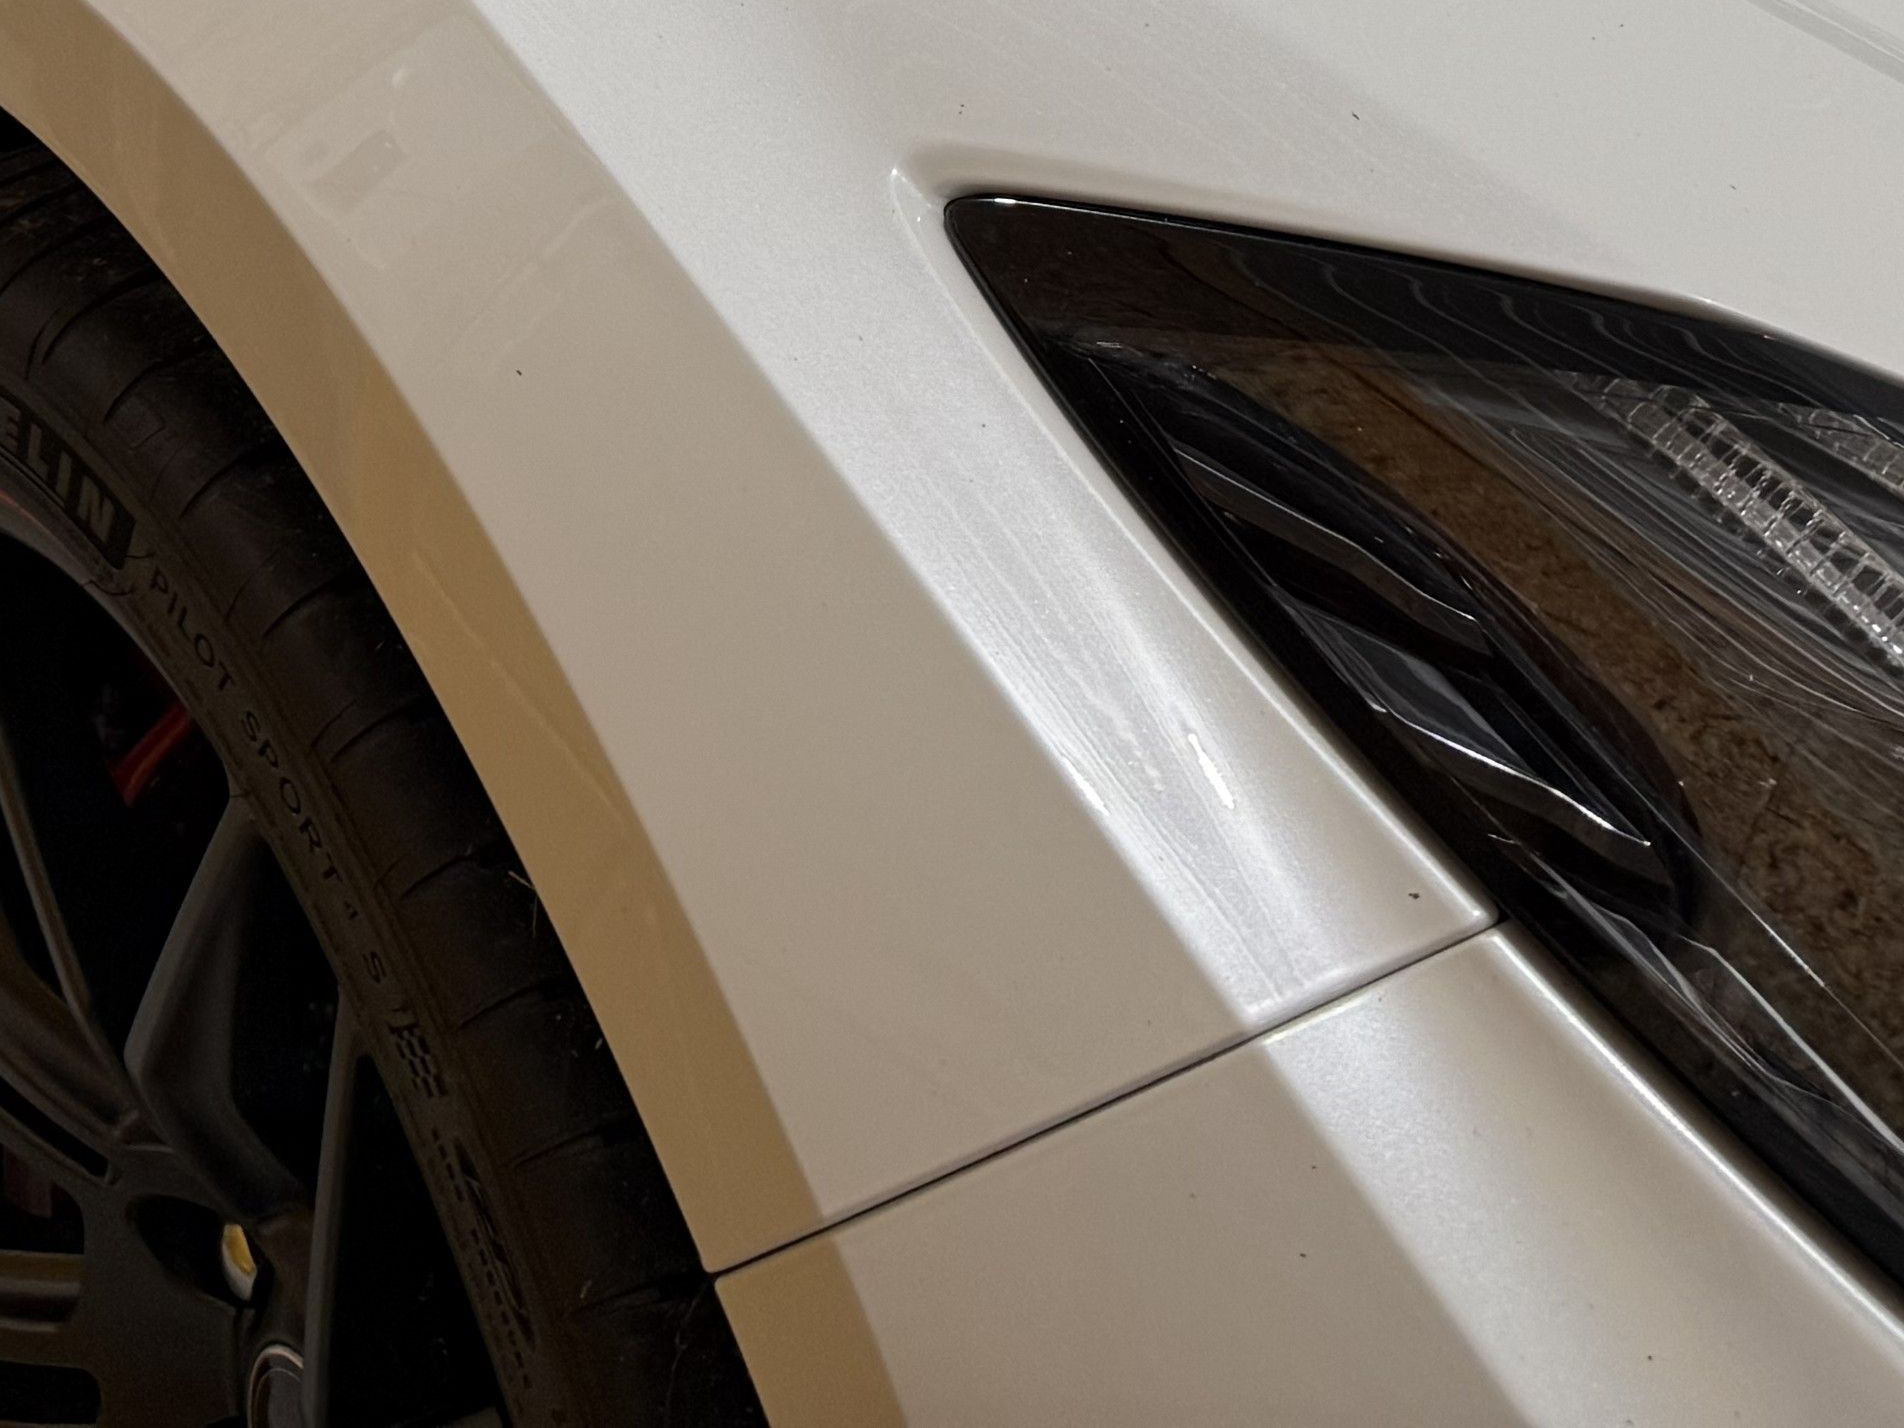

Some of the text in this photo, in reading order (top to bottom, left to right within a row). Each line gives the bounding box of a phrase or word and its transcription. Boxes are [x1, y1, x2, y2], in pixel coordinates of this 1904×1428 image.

[149, 567, 235, 691] PILOT
[241, 710, 343, 883] SPORT
[361, 950, 388, 985] S
